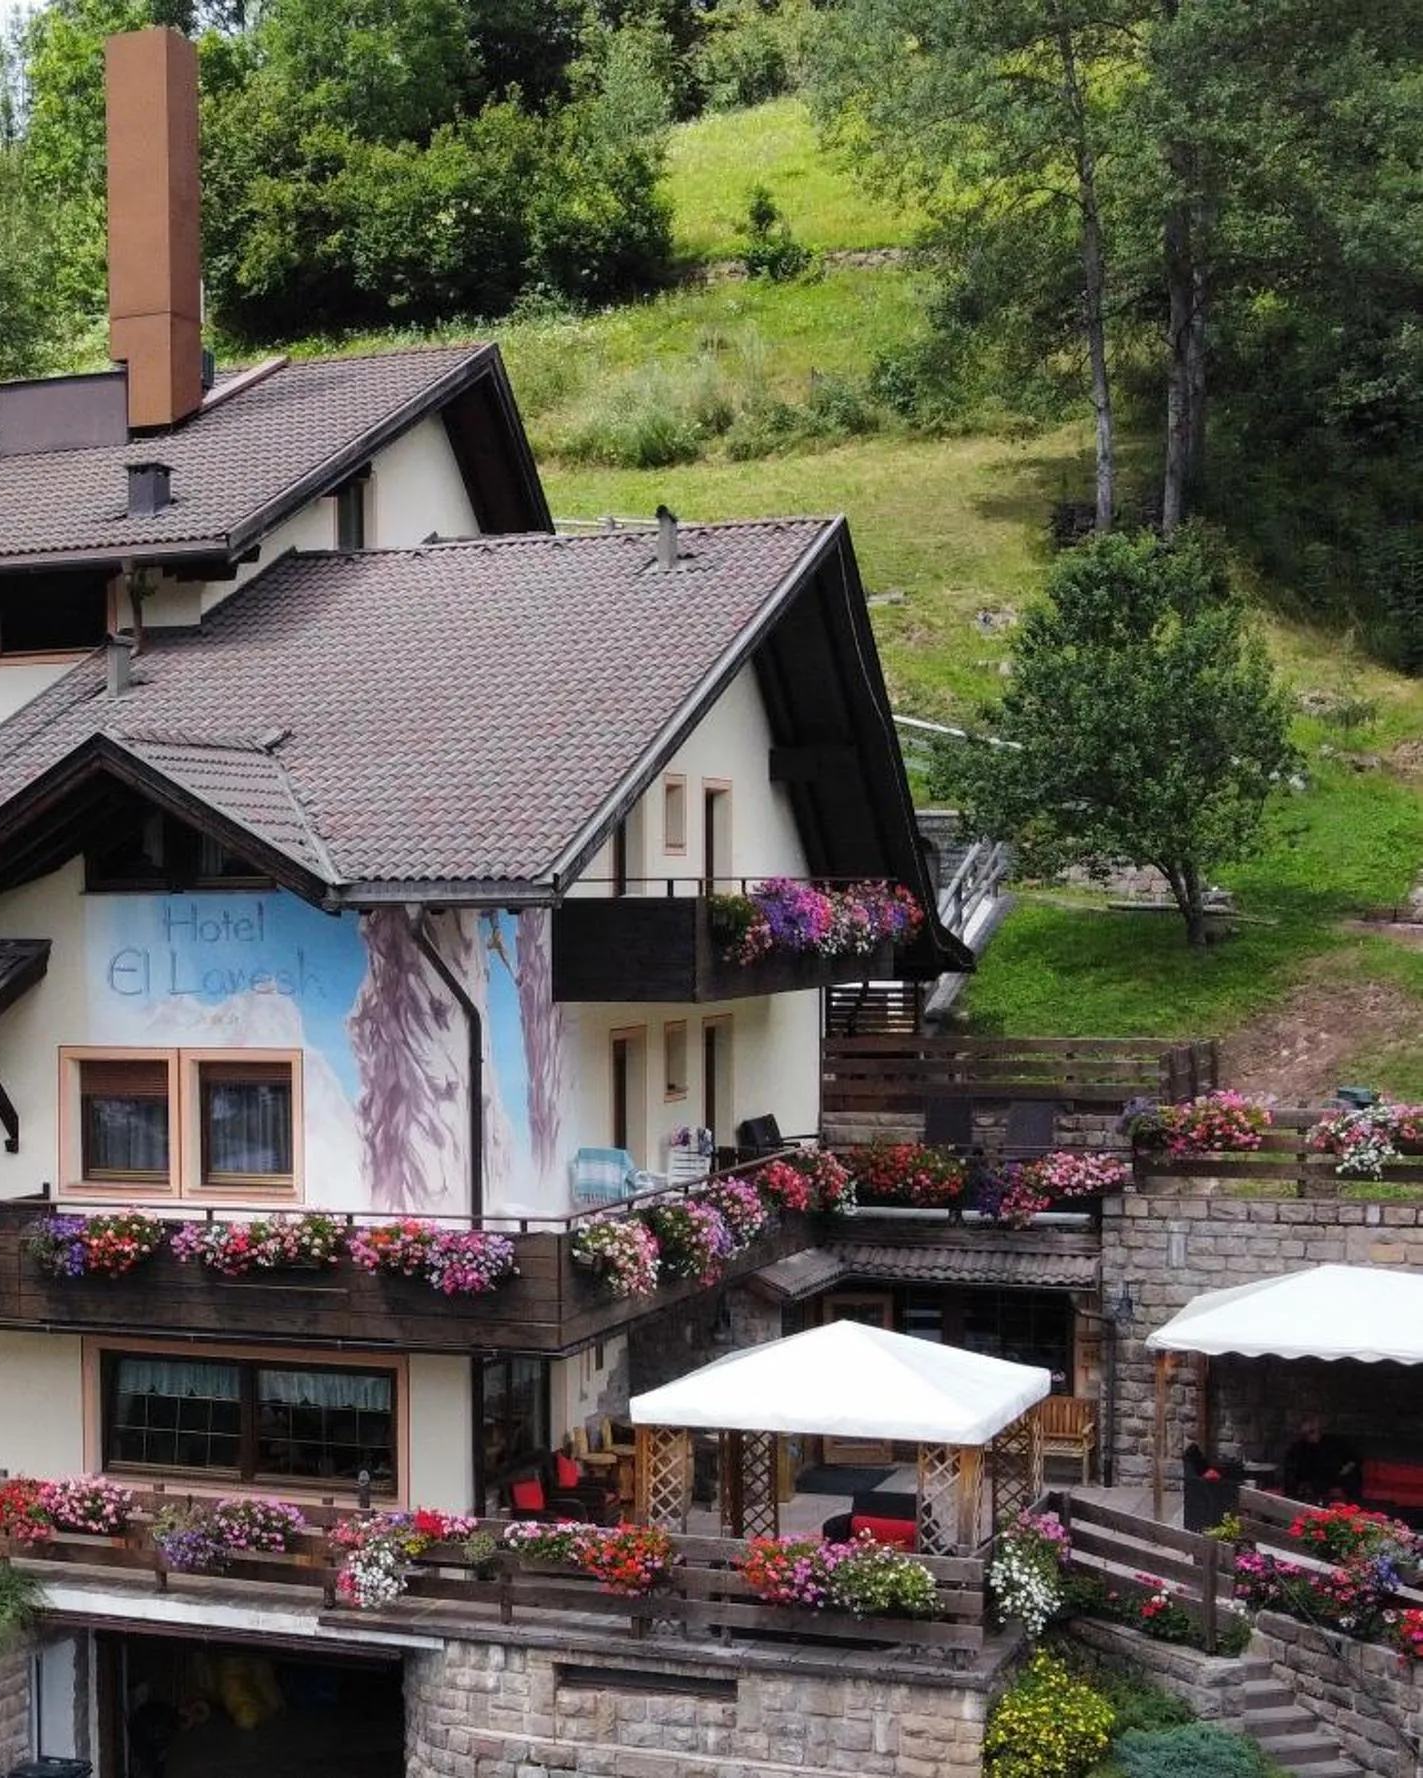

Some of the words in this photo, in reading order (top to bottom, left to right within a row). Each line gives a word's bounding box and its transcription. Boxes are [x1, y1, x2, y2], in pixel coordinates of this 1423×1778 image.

[163, 901, 265, 943] Hotel
[108, 948, 151, 996] El
[168, 948, 325, 997] Laresh
